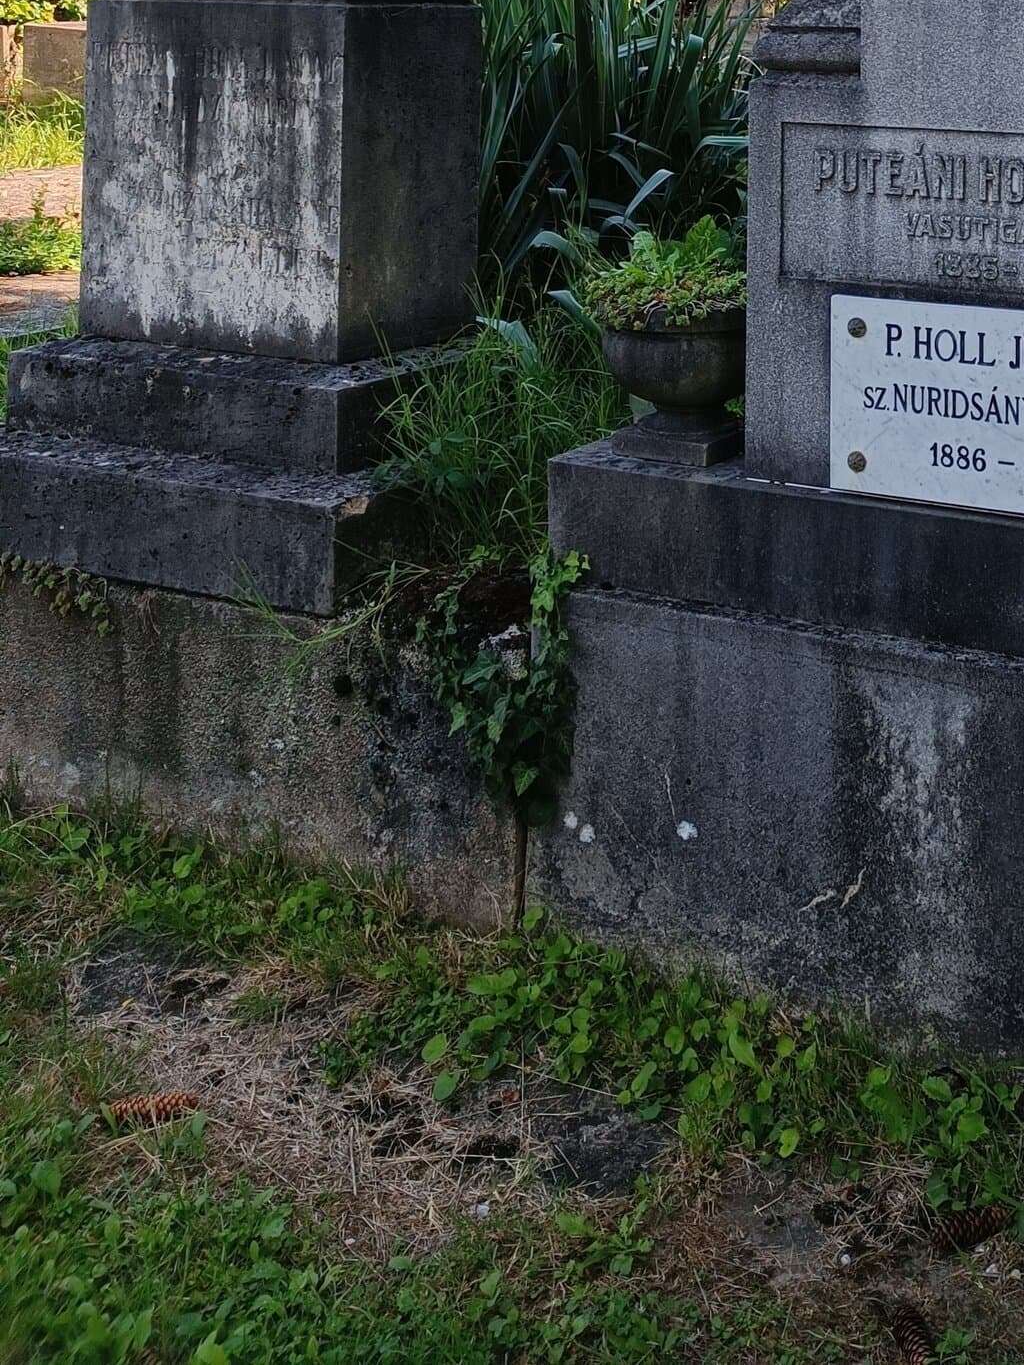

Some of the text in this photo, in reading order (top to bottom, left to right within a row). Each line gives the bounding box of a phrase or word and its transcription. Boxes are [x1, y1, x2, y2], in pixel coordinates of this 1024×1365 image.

[814, 141, 966, 200] PUTEÁNI
[885, 323, 903, 357] P.
[913, 326, 997, 367] HOLL
[929, 442, 987, 472] 1886
